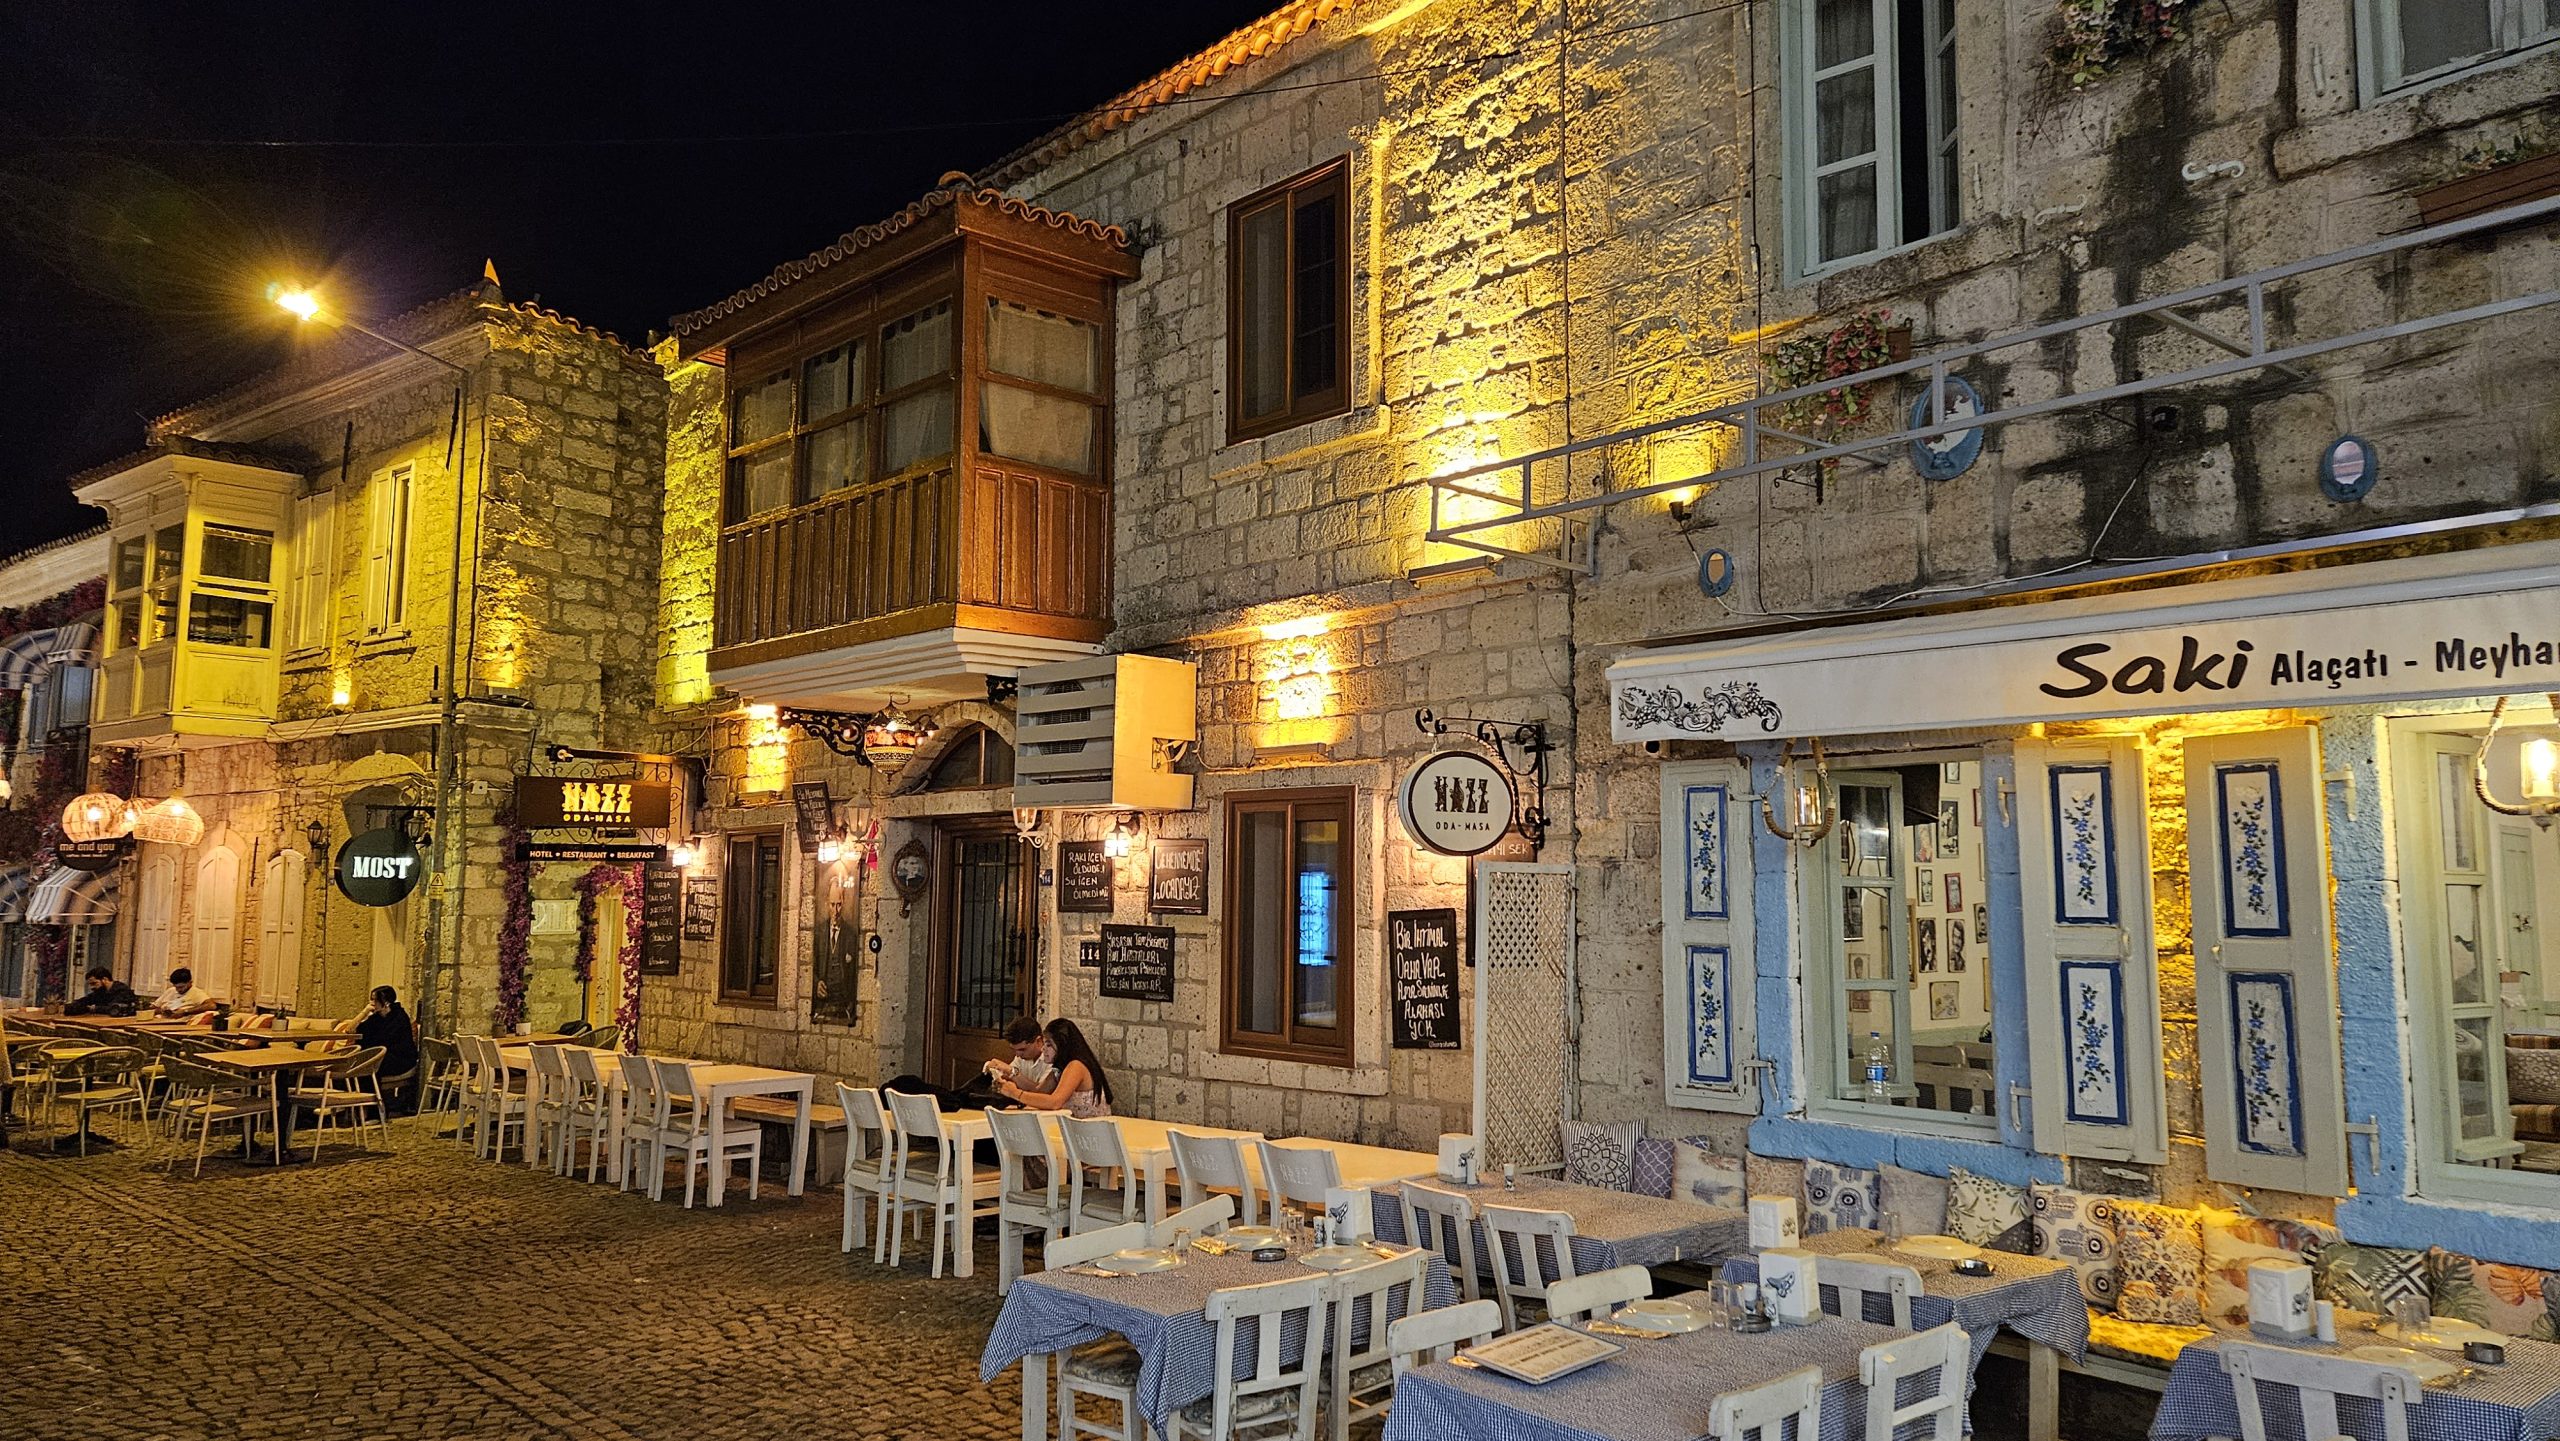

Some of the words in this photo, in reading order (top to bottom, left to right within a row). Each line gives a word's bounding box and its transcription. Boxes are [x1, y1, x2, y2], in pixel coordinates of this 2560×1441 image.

[2040, 636, 2254, 699] Saki
[2270, 649, 2389, 689] Alaçatı
[2436, 631, 2560, 678] Meyha
[562, 782, 632, 813] HAZZ
[1434, 776, 1489, 813] HAZZ
[563, 815, 631, 823] ODA-MASA
[60, 843, 75, 851] me
[77, 842, 95, 851] and
[97, 843, 115, 853] you
[562, 851, 607, 859] RESTAURANT
[617, 851, 655, 859] BREAKFAST
[1068, 851, 1087, 863] RAKI
[352, 856, 414, 880] MOST
[1065, 876, 1076, 886] SU
[1080, 948, 1100, 960] 114
[1397, 952, 1421, 980] DAHA
[1421, 952, 1446, 980] VAR
[1408, 1019, 1437, 1040] YOK
